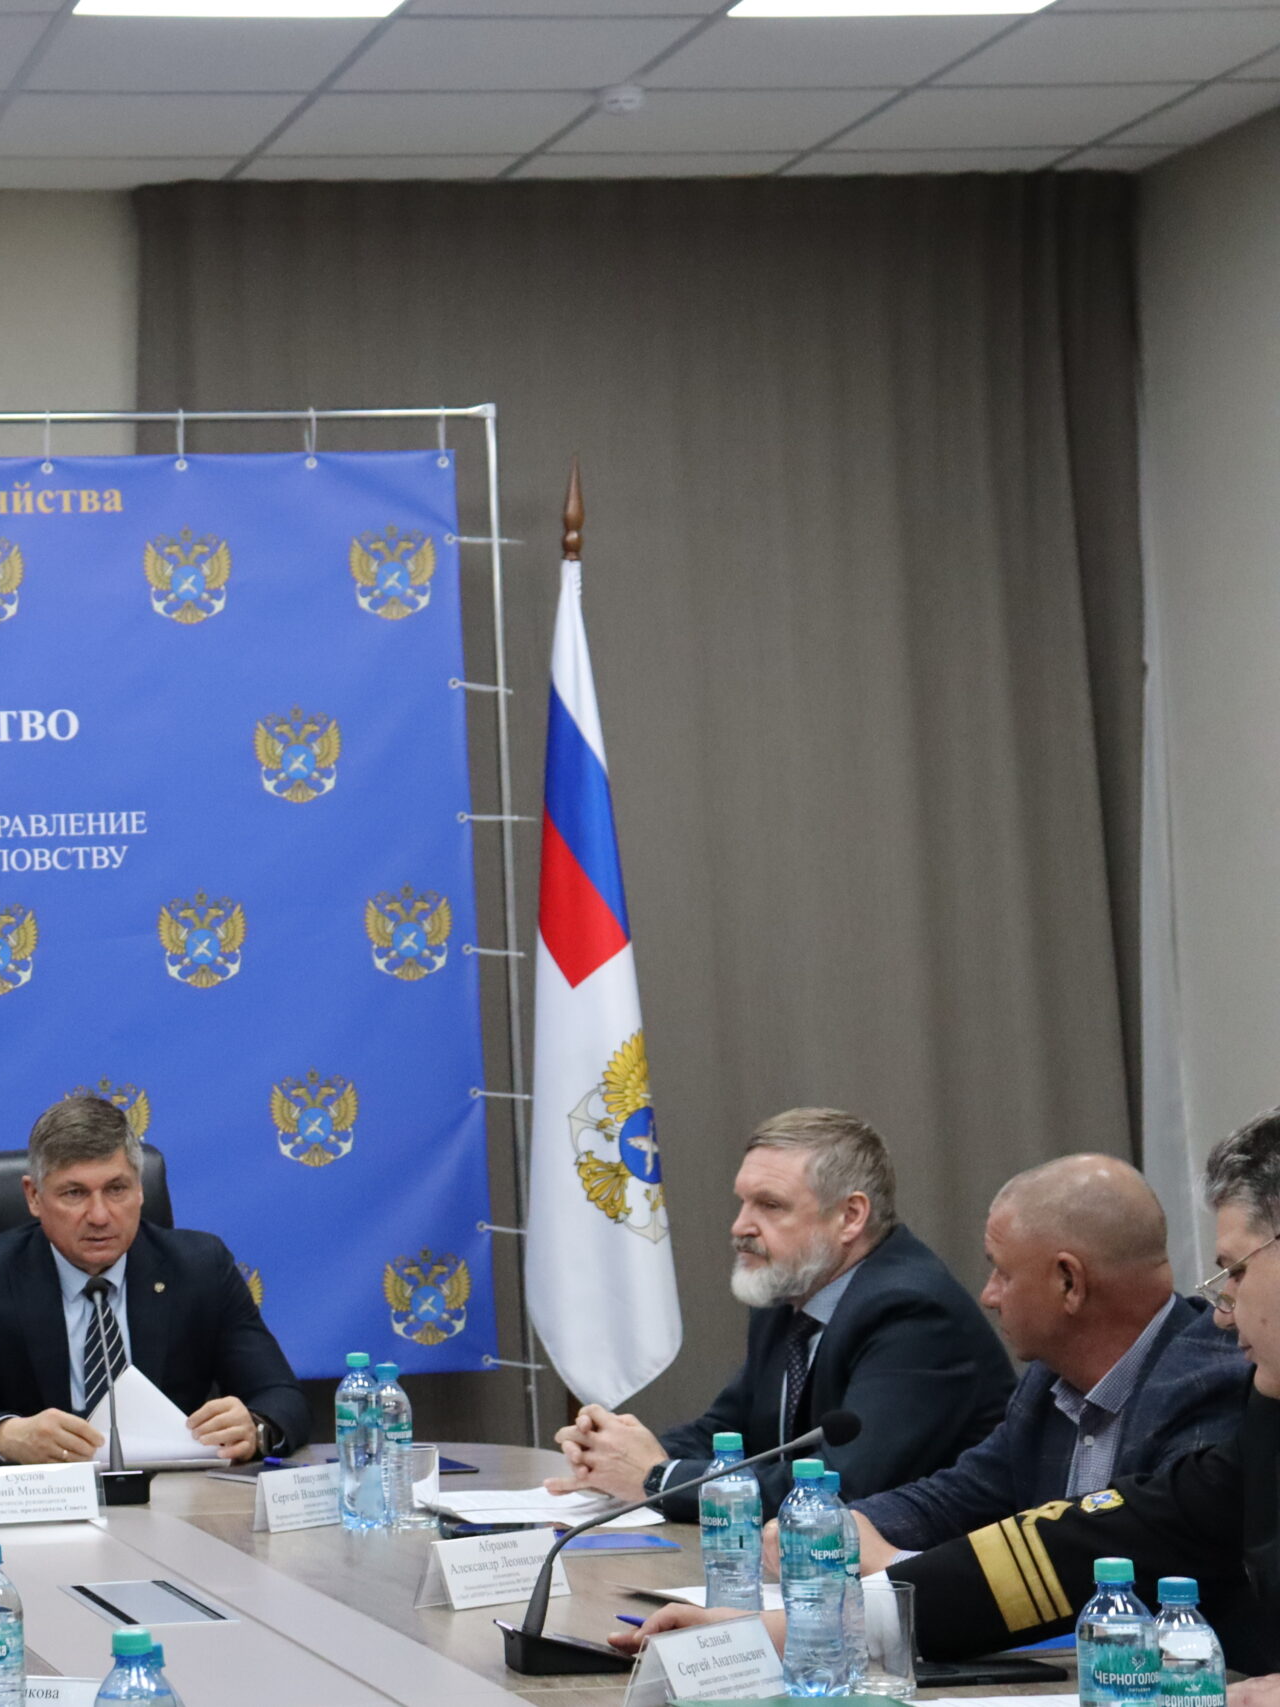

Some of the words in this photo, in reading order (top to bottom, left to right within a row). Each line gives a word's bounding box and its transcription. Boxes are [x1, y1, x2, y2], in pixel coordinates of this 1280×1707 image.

[17, 1484, 86, 1498] Михайлович
[478, 1539, 519, 1554] Абрамов
[450, 1560, 499, 1576] Александр
[501, 1553, 547, 1569] Леонидов
[696, 1630, 733, 1649] Бедный
[677, 1656, 711, 1678] Сергей
[712, 1647, 768, 1669] Анатольевич
